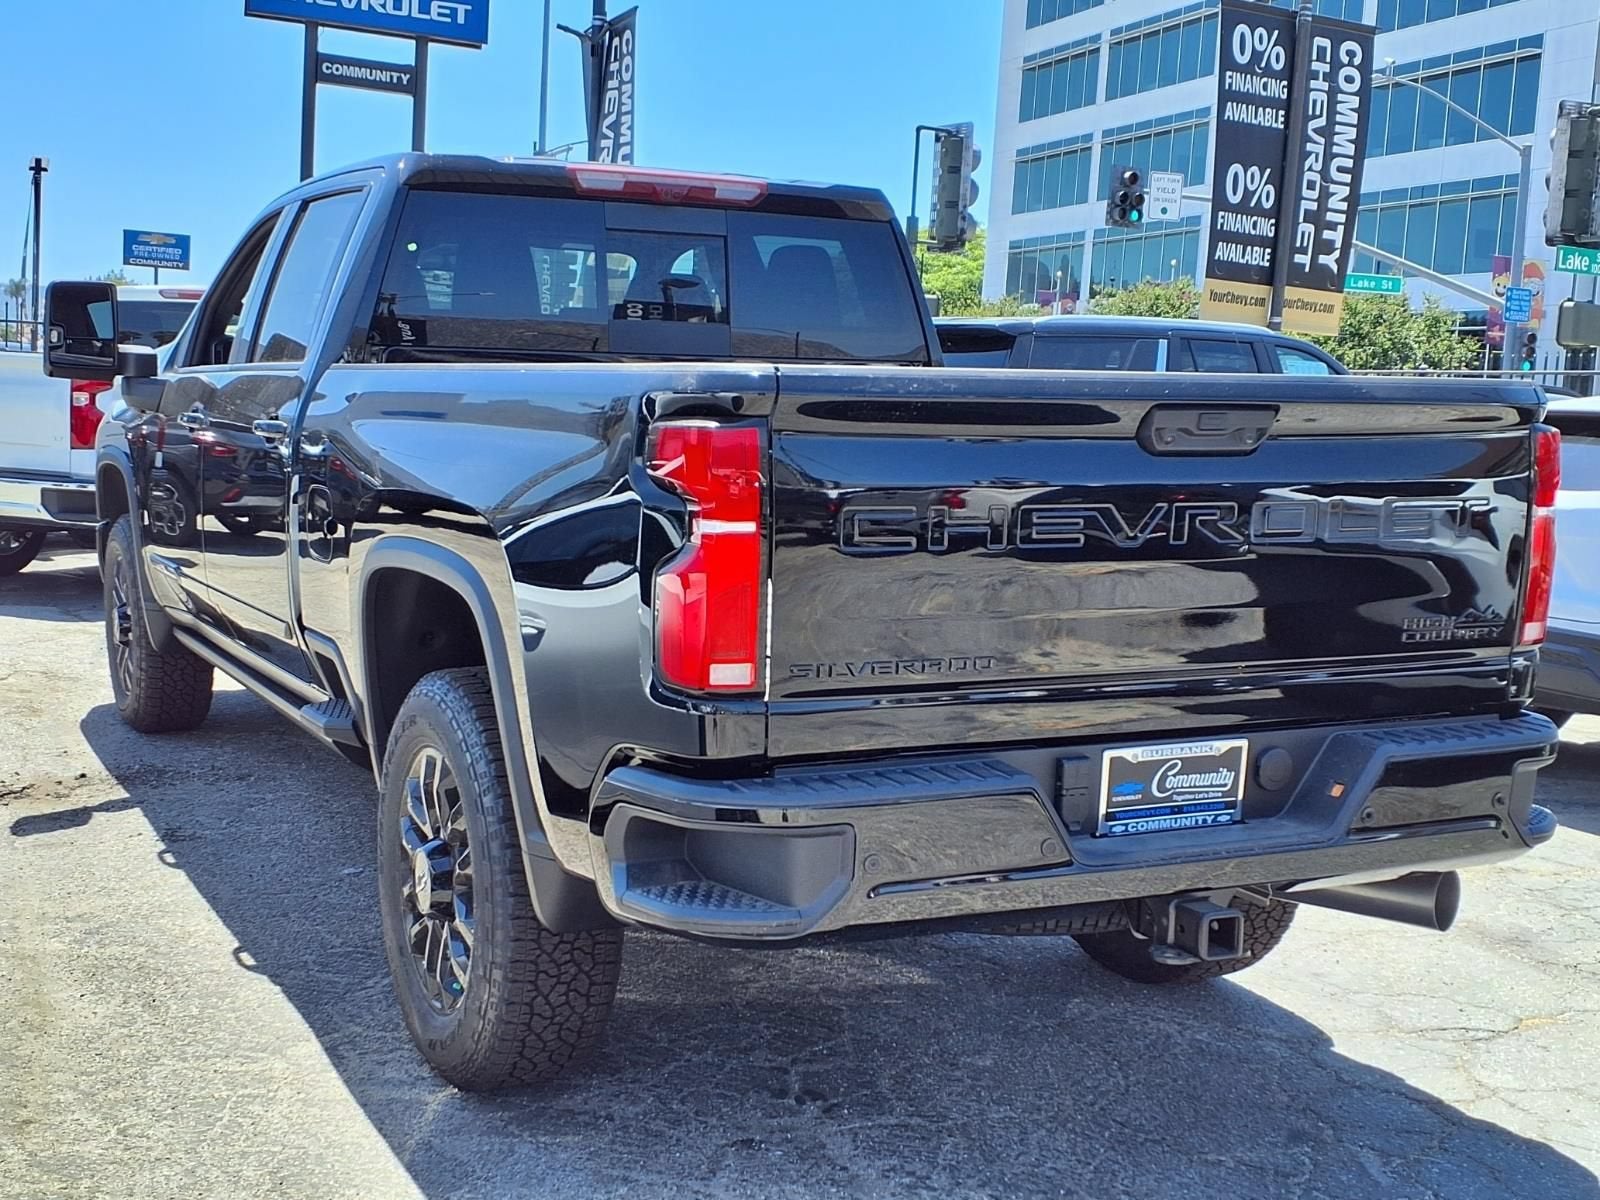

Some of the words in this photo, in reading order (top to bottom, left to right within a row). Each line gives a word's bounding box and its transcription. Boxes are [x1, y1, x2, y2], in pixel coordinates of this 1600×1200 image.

[292, 0, 472, 24] ROLET
[1232, 23, 1286, 71] 0%
[321, 61, 411, 85] COMMUNITY
[1225, 71, 1288, 100] FINANCING
[1224, 102, 1285, 129] AVAILABLE
[1294, 36, 1332, 273] CHEVROLET
[1318, 40, 1363, 275] COMMUNITY
[1225, 163, 1275, 209] 0%
[1217, 211, 1276, 238] FINANCING
[132, 244, 182, 255] CERTIFIED
[133, 250, 180, 260] PRE-OWNED
[1214, 242, 1272, 267] AVAILABLE
[1559, 249, 1590, 271] Lake
[129, 258, 184, 268] COMMUNITY
[1350, 277, 1376, 289] Lake
[1381, 279, 1393, 290] St
[1209, 288, 1266, 308] YourChevy.com
[839, 499, 1490, 551] CHEVROLET
[1402, 616, 1457, 629] HIGH
[1401, 627, 1504, 643] COUNTRY
[788, 655, 1000, 680] SILVERADO
[1142, 744, 1214, 758] BURBANK
[1151, 759, 1235, 798] Community
[1127, 815, 1215, 832] COMMUNITY
